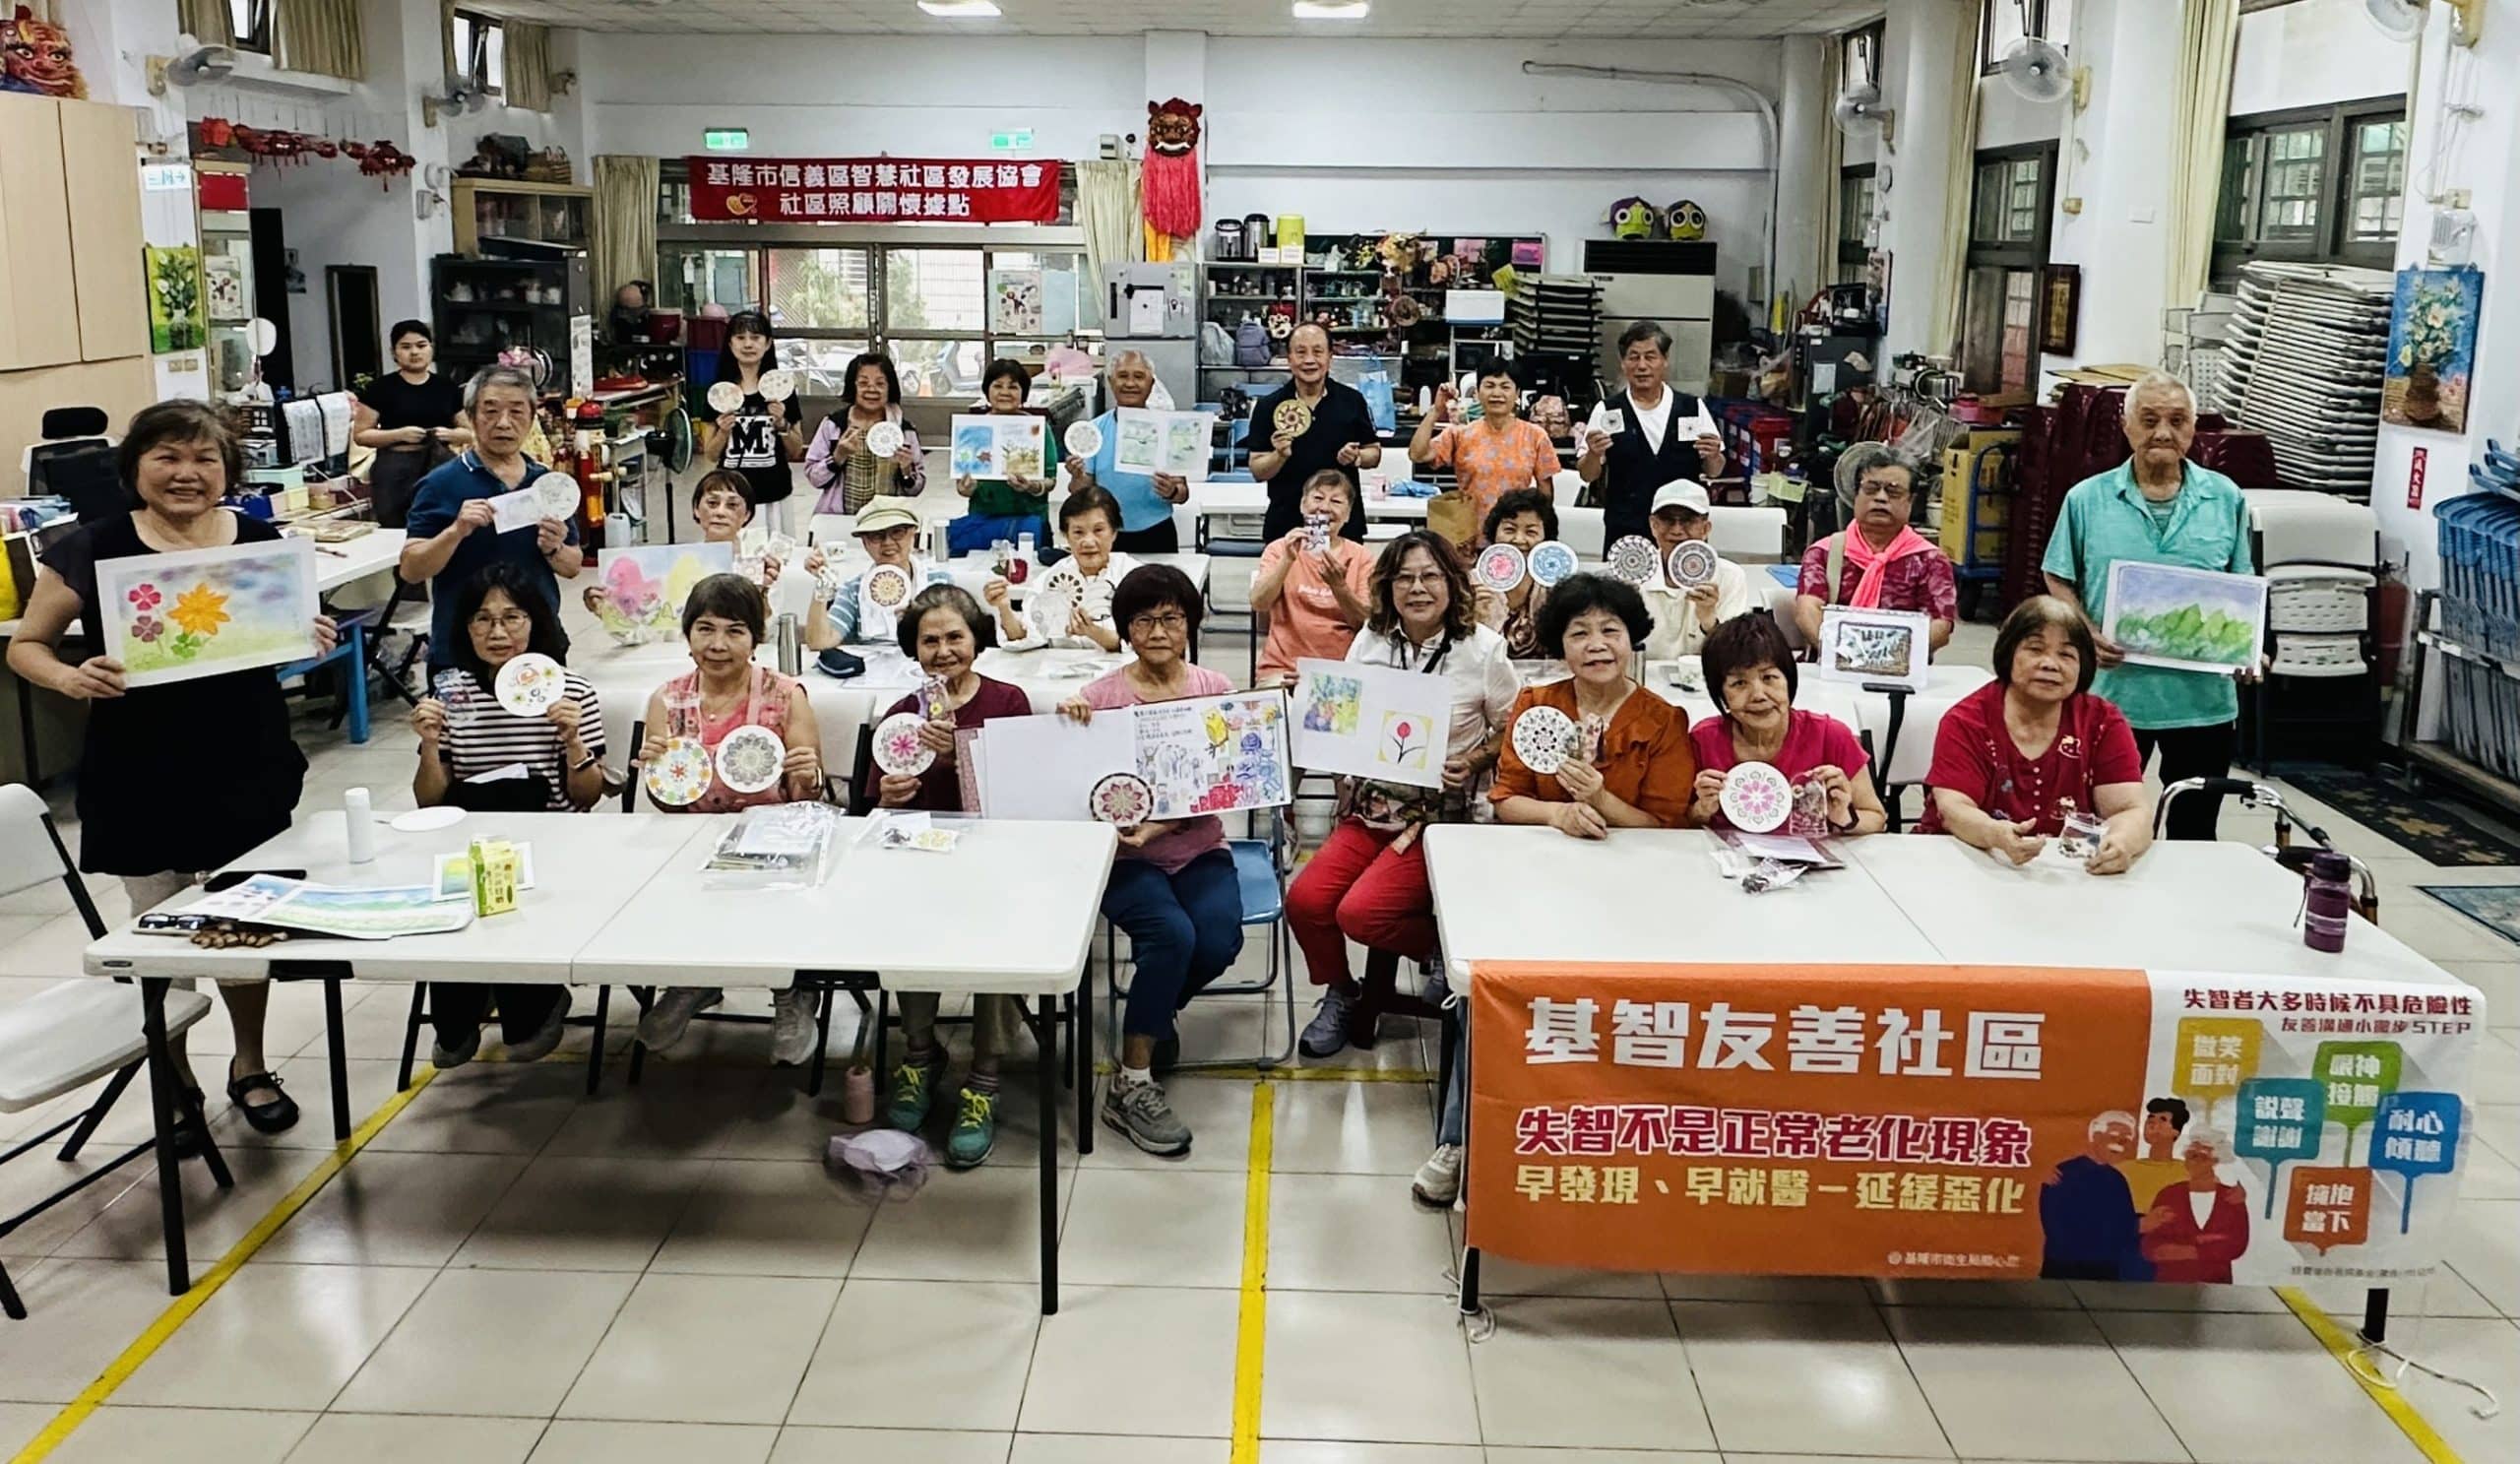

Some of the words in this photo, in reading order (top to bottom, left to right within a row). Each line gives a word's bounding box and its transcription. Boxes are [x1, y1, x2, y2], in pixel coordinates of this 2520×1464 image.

[707, 162, 1043, 188] 基隆市信義區智慧社區發展協會
[780, 192, 971, 217] 社區照顧關懷據點
[2183, 988, 2472, 1015] 失智者大多時候不具危險性
[1525, 996, 2046, 1080] 基智友善社區
[2192, 1035, 2243, 1059] 微笑
[2190, 1062, 2239, 1086] 面對
[2329, 1054, 2381, 1079] 眼神
[2327, 1083, 2379, 1108] 接觸
[2253, 1096, 2305, 1121] 說聲
[2388, 1109, 2444, 1134] 耐心
[1517, 1106, 2033, 1168] 失智不是正常老化現象
[2385, 1137, 2441, 1162] 傾聽
[2305, 1184, 2355, 1207] 擁抱
[2301, 1211, 2352, 1234] 當下
